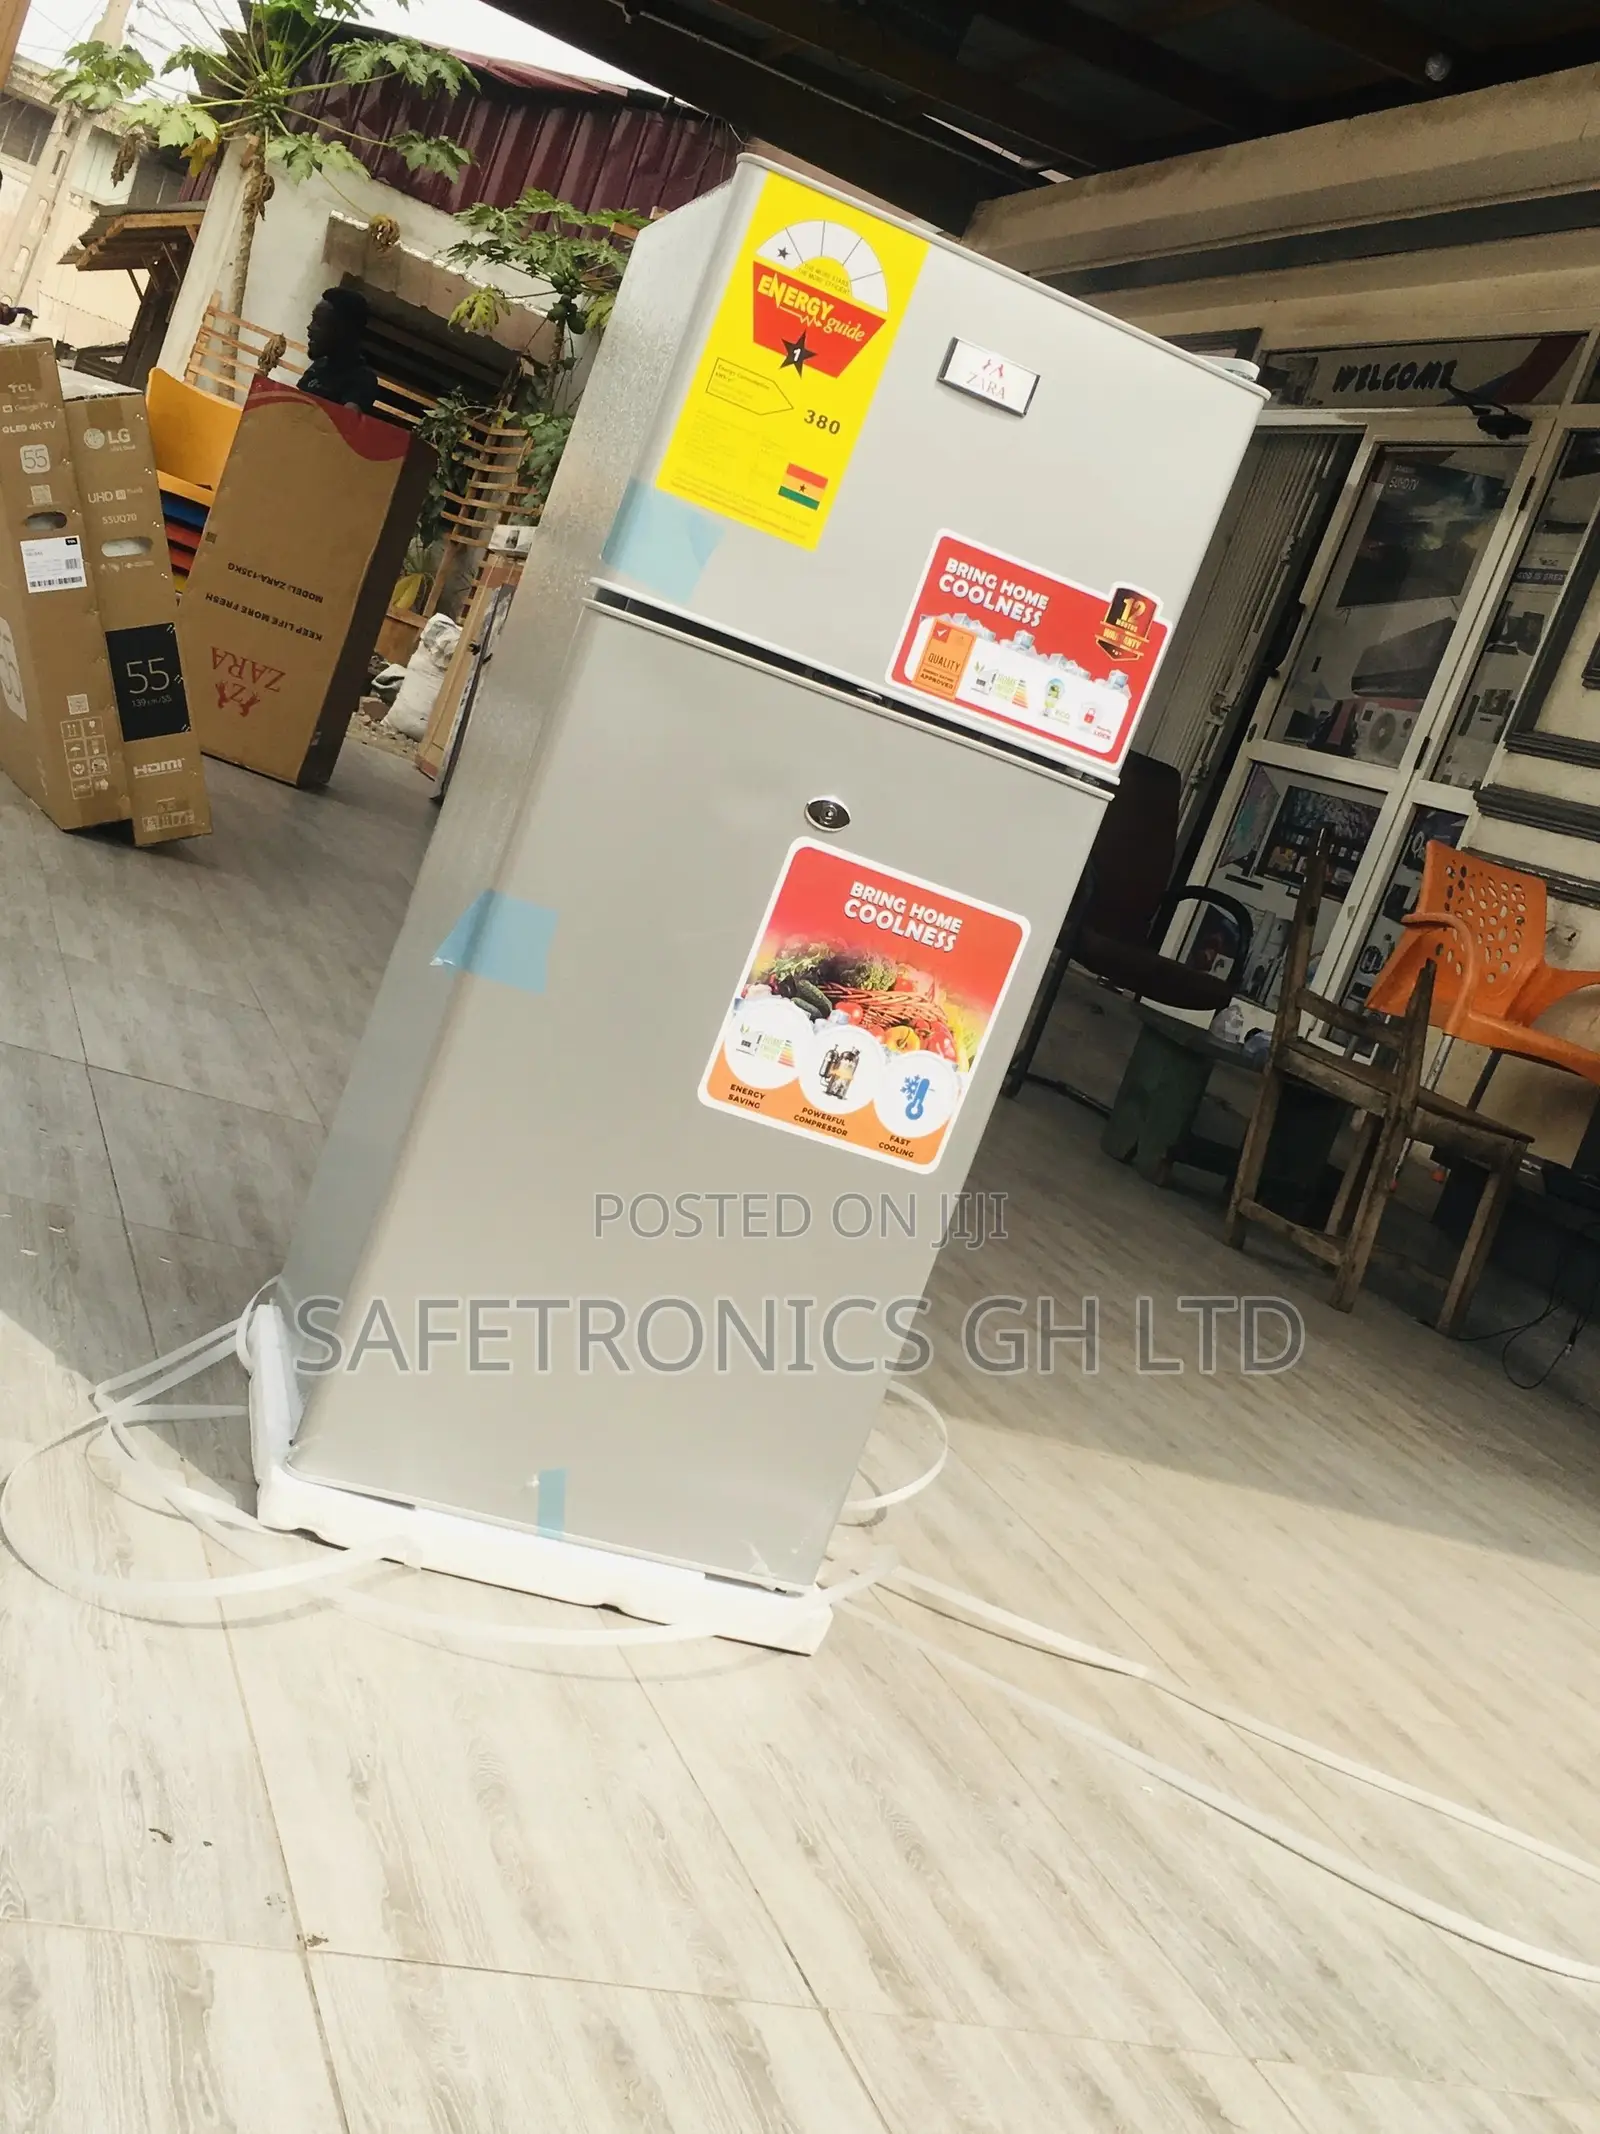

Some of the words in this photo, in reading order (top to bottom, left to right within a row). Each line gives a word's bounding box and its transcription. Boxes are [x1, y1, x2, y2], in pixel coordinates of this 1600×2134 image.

[757, 273, 834, 321] ENERGY
[823, 317, 866, 342] guide
[793, 348, 802, 362] 1
[1332, 359, 1458, 393] WELCOME
[7, 383, 36, 393] TCL
[2, 424, 28, 434] QLED
[29, 421, 42, 431] 4K
[42, 420, 56, 429] TV
[804, 409, 841, 435] 380
[107, 428, 131, 444] LG
[23, 449, 48, 470] 55
[87, 490, 114, 504] UHD
[945, 557, 998, 590] BRING
[1000, 579, 1049, 610] HOME
[205, 592, 239, 611] FRESH
[939, 573, 1043, 628] COOLNESS
[1120, 598, 1146, 624] 12
[241, 605, 270, 623] MORE
[272, 616, 295, 632] LIFE
[295, 627, 323, 642] KEEP
[211, 646, 286, 693] ZARA
[928, 652, 961, 673] QUALITY
[126, 657, 170, 694] 55
[920, 673, 954, 690] APPROVED
[849, 881, 907, 915] BRING
[909, 902, 963, 935] HOME
[844, 898, 957, 953] COOLNESS
[728, 1094, 761, 1109] SAVING
[730, 1084, 766, 1100] ENERGY
[793, 1114, 849, 1137] COMPRESSOR
[801, 1106, 846, 1127] POWERFUL
[878, 1141, 915, 1158] COOLING
[889, 1134, 912, 1147] FAST
